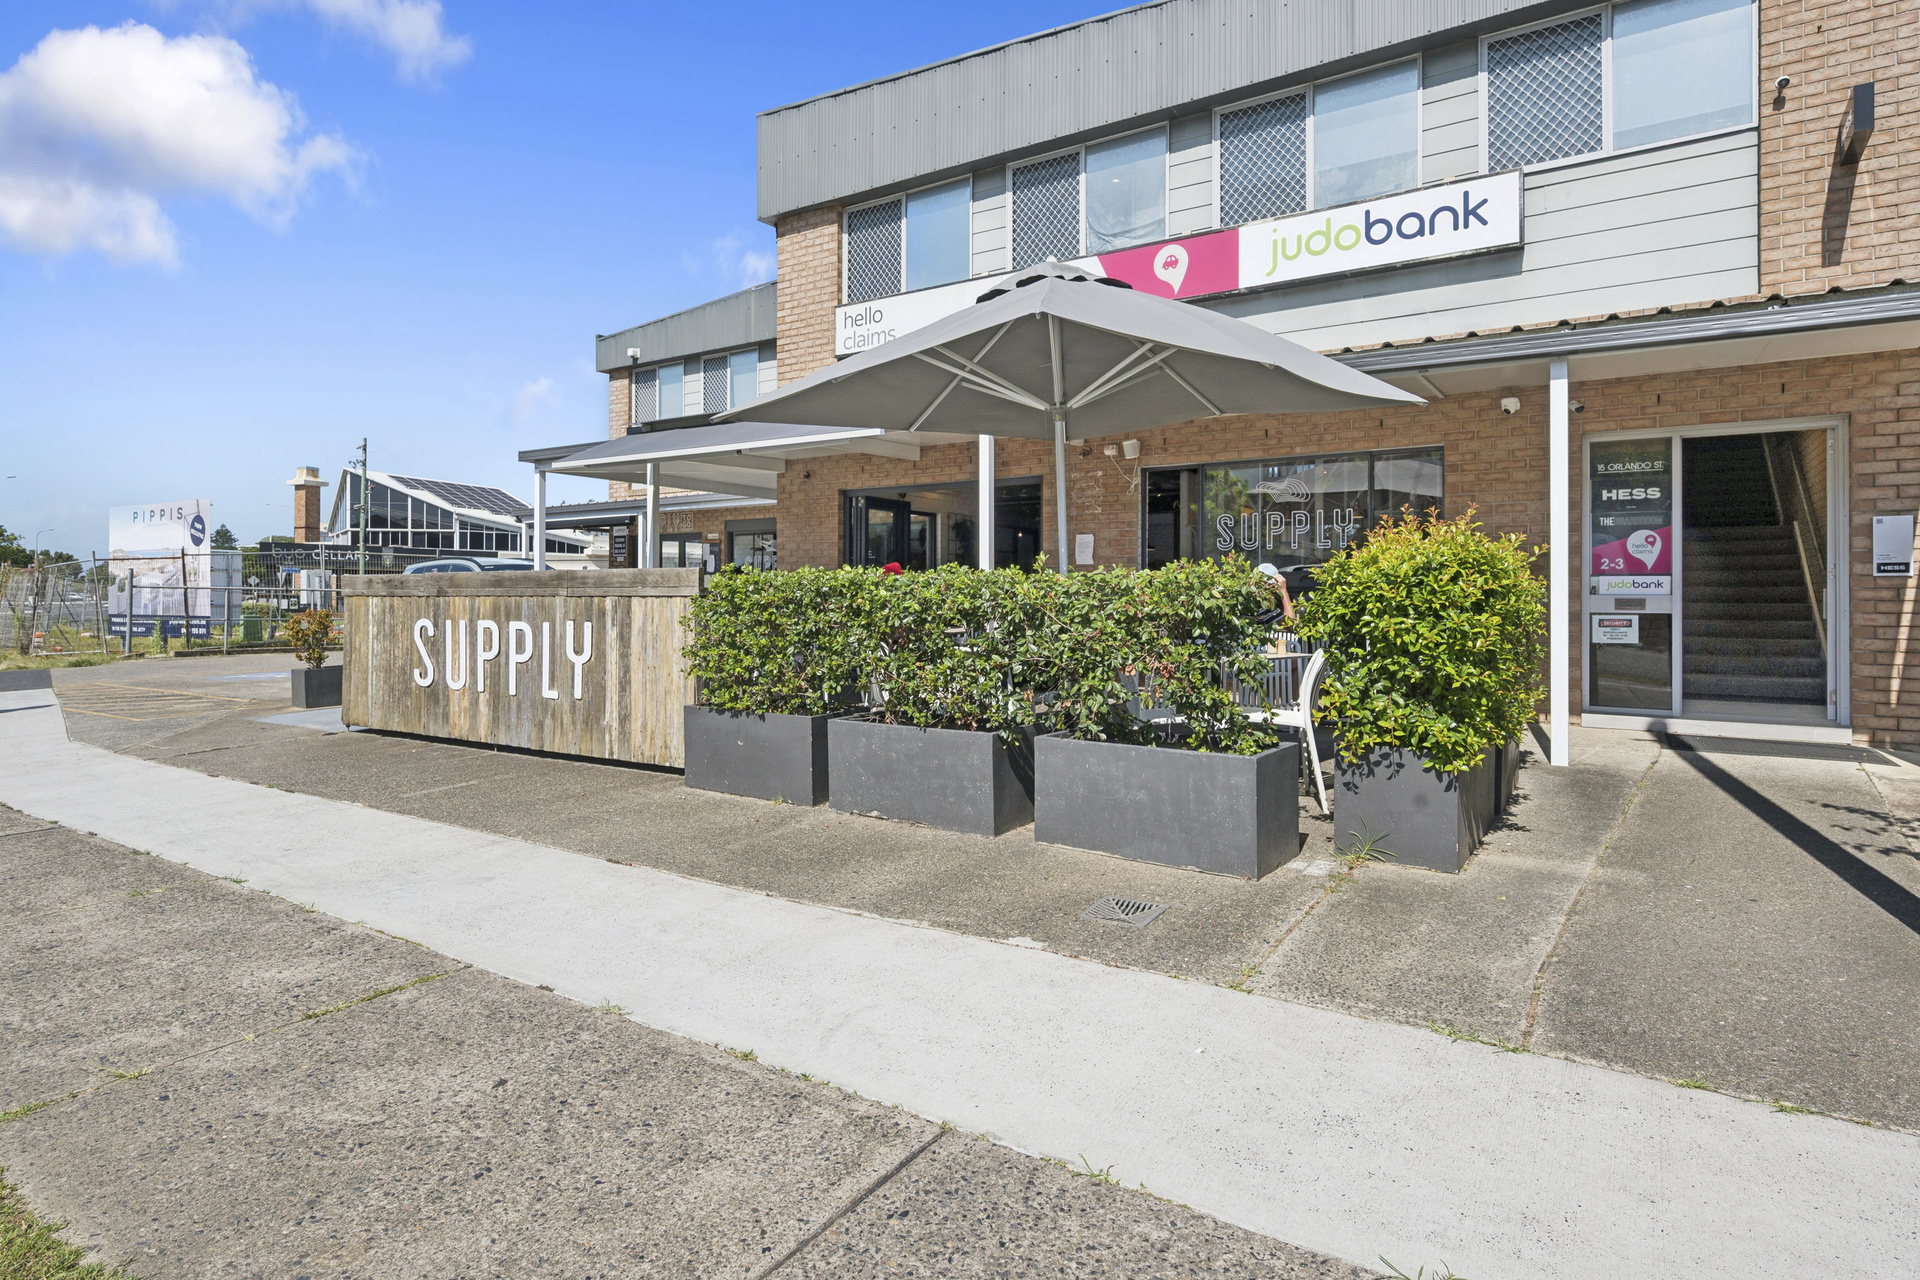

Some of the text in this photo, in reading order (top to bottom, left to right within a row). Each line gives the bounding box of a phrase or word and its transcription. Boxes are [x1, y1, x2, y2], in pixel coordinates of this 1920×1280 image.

[1265, 190, 1488, 277] judobank
[844, 306, 883, 329] hello
[843, 328, 896, 350] claims
[1607, 461, 1652, 471] ORLANDO
[1602, 487, 1661, 501] HESS
[132, 506, 184, 523] PIPPIS
[1599, 516, 1615, 526] THE
[1216, 508, 1354, 550] SUPPLY
[1600, 558, 1624, 570] 2-3
[1606, 579, 1664, 591] judobank
[413, 618, 593, 700] SUPPLY
